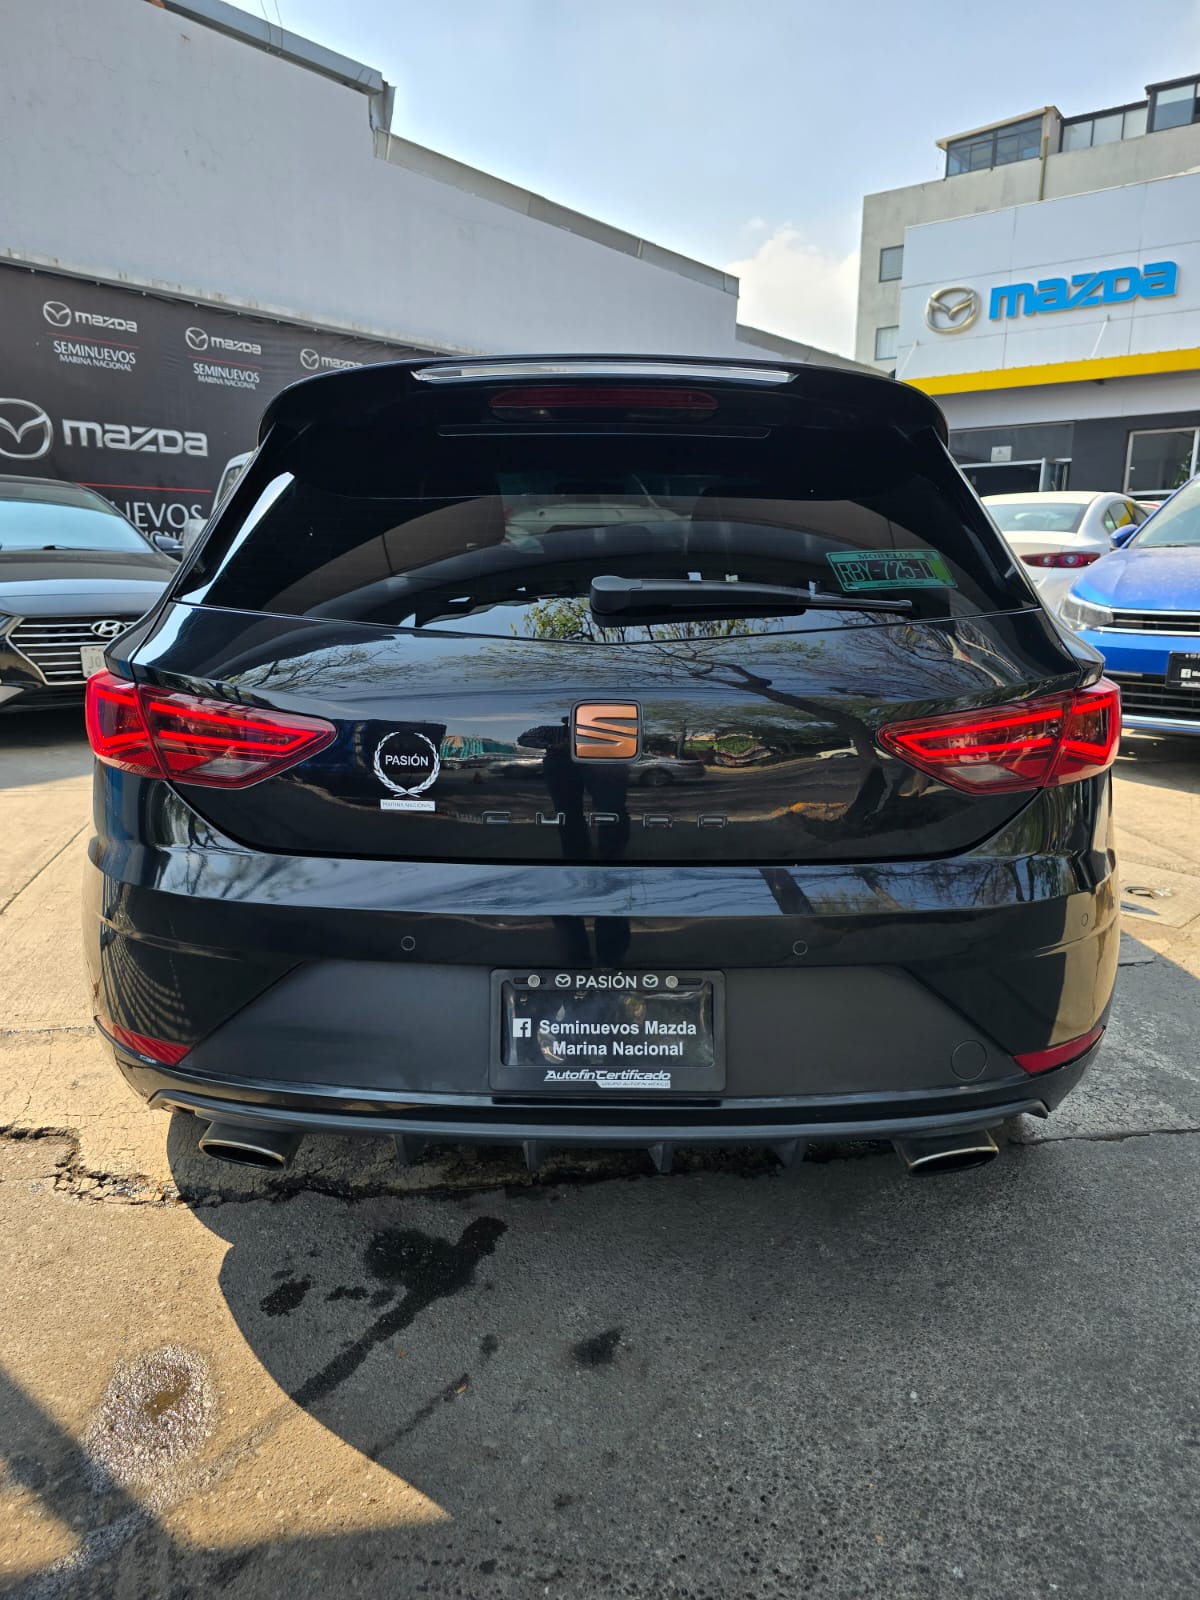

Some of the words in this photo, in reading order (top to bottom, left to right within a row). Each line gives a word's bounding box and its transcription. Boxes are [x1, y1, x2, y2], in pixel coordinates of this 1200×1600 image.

[989, 261, 1178, 320] mazda
[74, 311, 137, 333] mazda
[53, 340, 136, 364] SEMINUEVOS
[210, 336, 262, 355] mazda
[59, 354, 92, 366] MARINA
[93, 359, 132, 372] NACIONAL
[193, 362, 260, 383] SEMINUEVOS
[62, 419, 208, 457] mazda
[858, 552, 915, 560] MORELOS
[385, 753, 429, 766] PASIÓN
[576, 972, 637, 988] PASIÓN
[539, 1020, 639, 1035] Seminuevos
[645, 1021, 696, 1035] Mazda
[553, 1041, 607, 1056] Marina
[612, 1042, 683, 1056] Nacional
